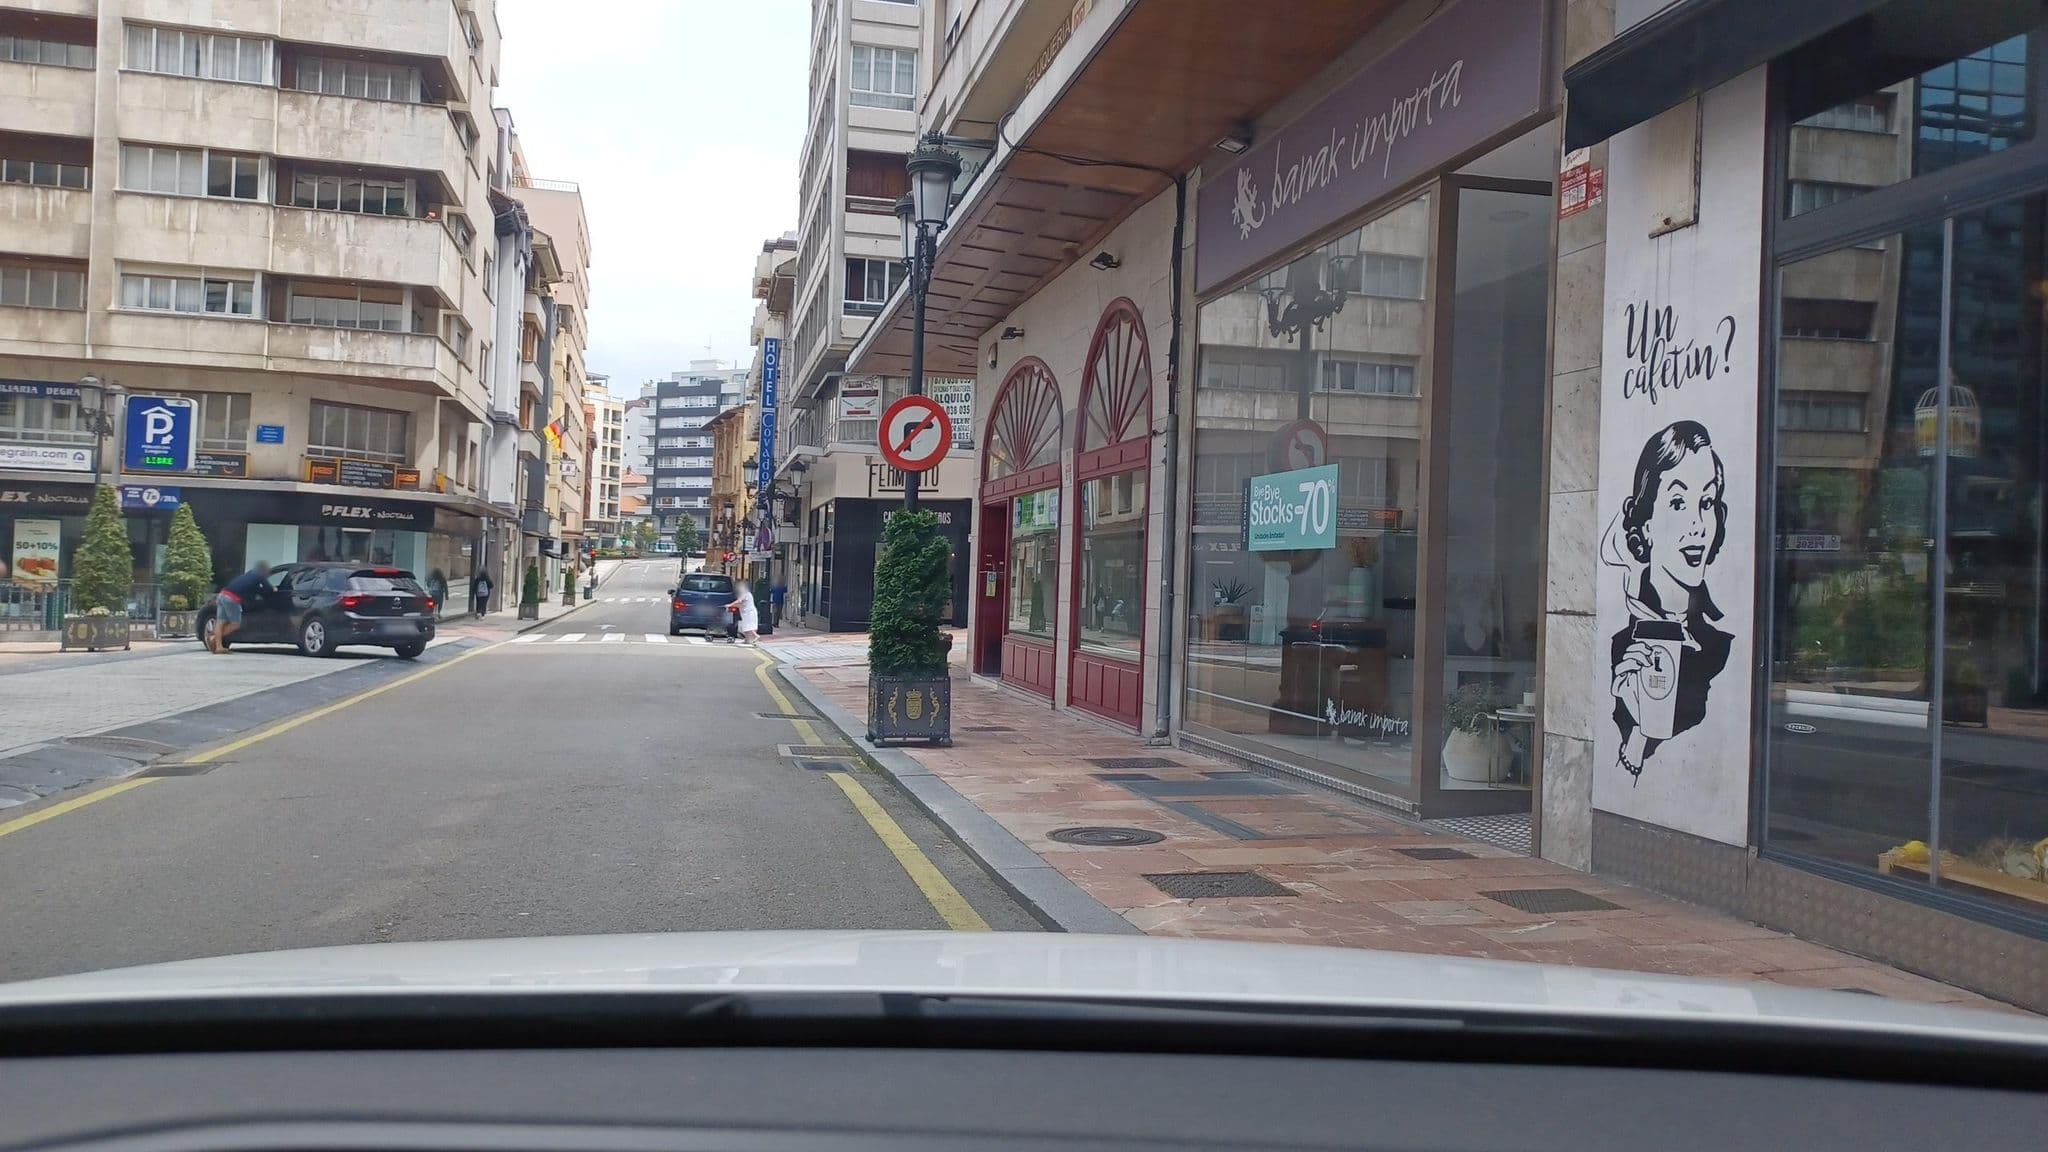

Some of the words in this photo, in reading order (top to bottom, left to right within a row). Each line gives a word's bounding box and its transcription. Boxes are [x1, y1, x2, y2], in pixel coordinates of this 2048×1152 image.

[1271, 128, 1345, 216] banak
[1351, 60, 1464, 179] importa
[1624, 300, 1679, 364] Un
[766, 341, 776, 406] HOTEL
[46, 387, 80, 396] DEGRA
[934, 393, 971, 404] ALQUILO
[1265, 484, 1280, 504] Bye
[332, 505, 372, 518] FLEX
[1251, 498, 1294, 526] Stocks
[16, 541, 58, 550] 50+10%
[1341, 699, 1368, 727] banak
[1370, 713, 1408, 740] importa
